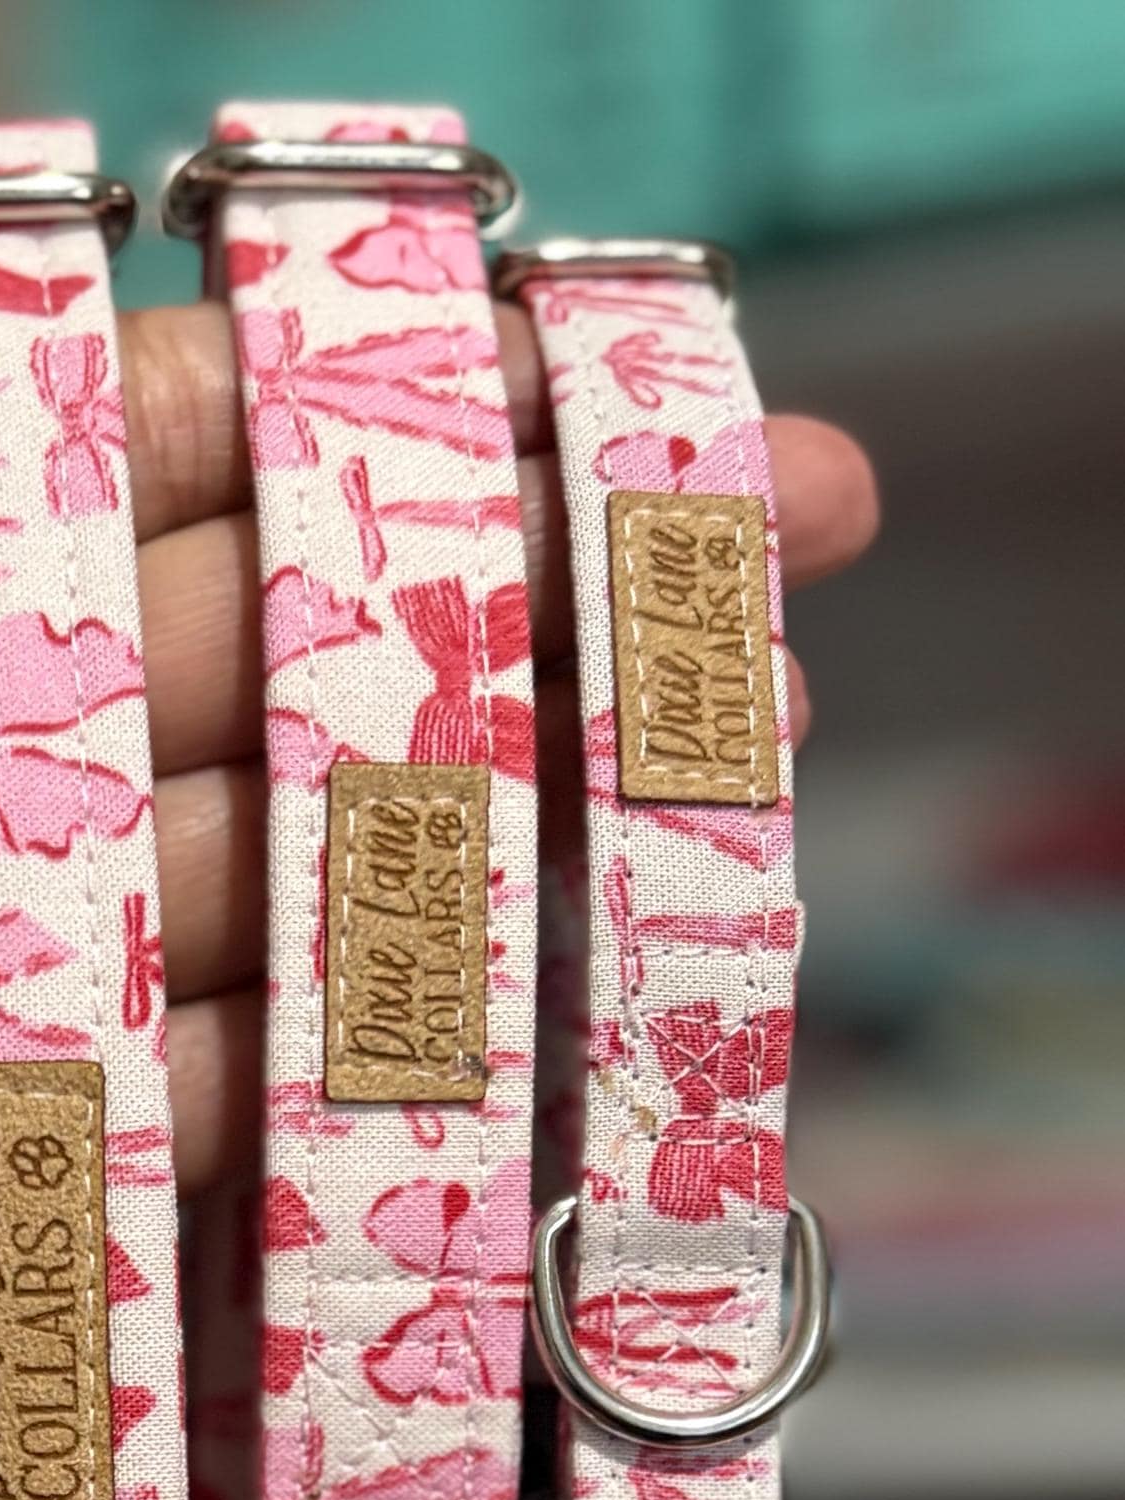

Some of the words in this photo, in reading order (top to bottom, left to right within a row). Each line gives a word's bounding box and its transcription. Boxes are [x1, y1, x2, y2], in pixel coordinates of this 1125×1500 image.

[635, 524, 703, 629] Lane
[645, 651, 712, 761] Dixie
[706, 586, 754, 764] COLLARS
[353, 801, 421, 918] Lane
[347, 942, 421, 1062] Dixie
[425, 868, 464, 1063] COLLARS
[11, 1218, 81, 1500] COLLARS
